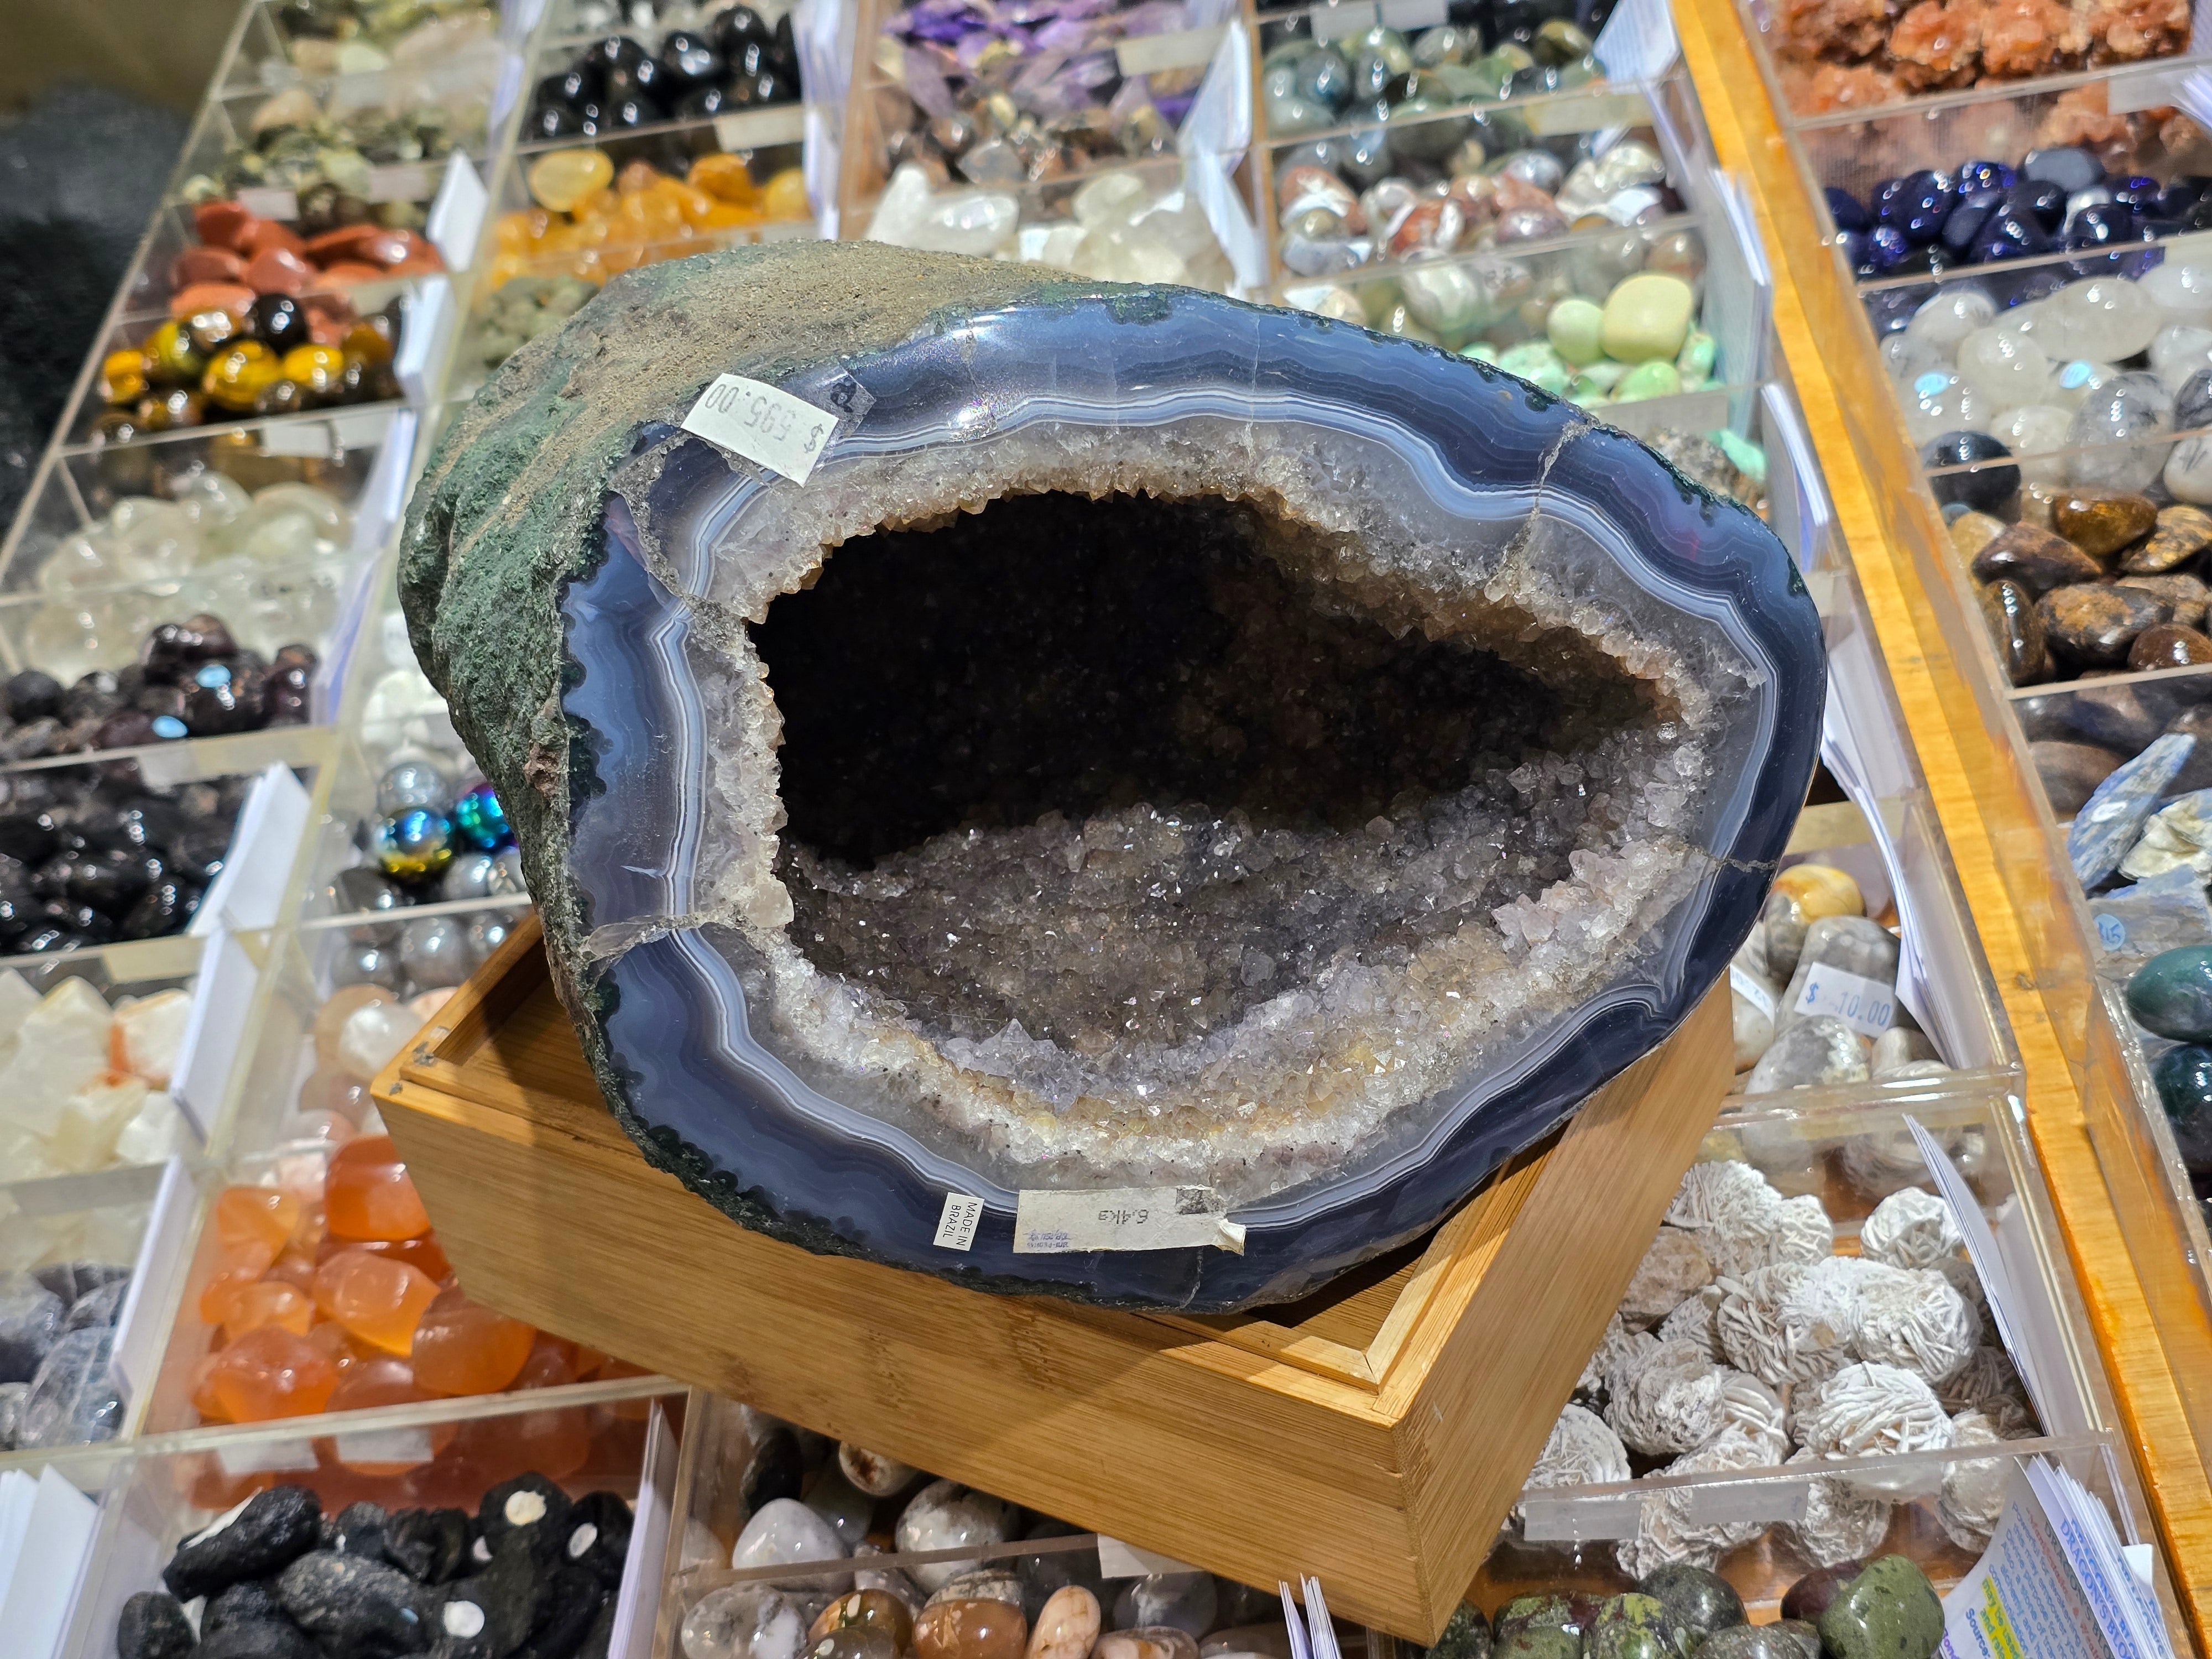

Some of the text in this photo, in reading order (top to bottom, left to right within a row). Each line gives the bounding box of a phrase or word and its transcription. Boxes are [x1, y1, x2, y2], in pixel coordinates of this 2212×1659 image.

[804, 423, 824, 453] $
[1806, 982, 1890, 1026] $ 10.00
[942, 1204, 962, 1238] BRAZIL
[956, 1202, 978, 1246] MADE IN
[1981, 1577, 1997, 1608] may
[2060, 1517, 2132, 1659] DRAGON'S BLO
[1980, 1608, 1996, 1635] and
[1989, 1564, 2028, 1657] communication
